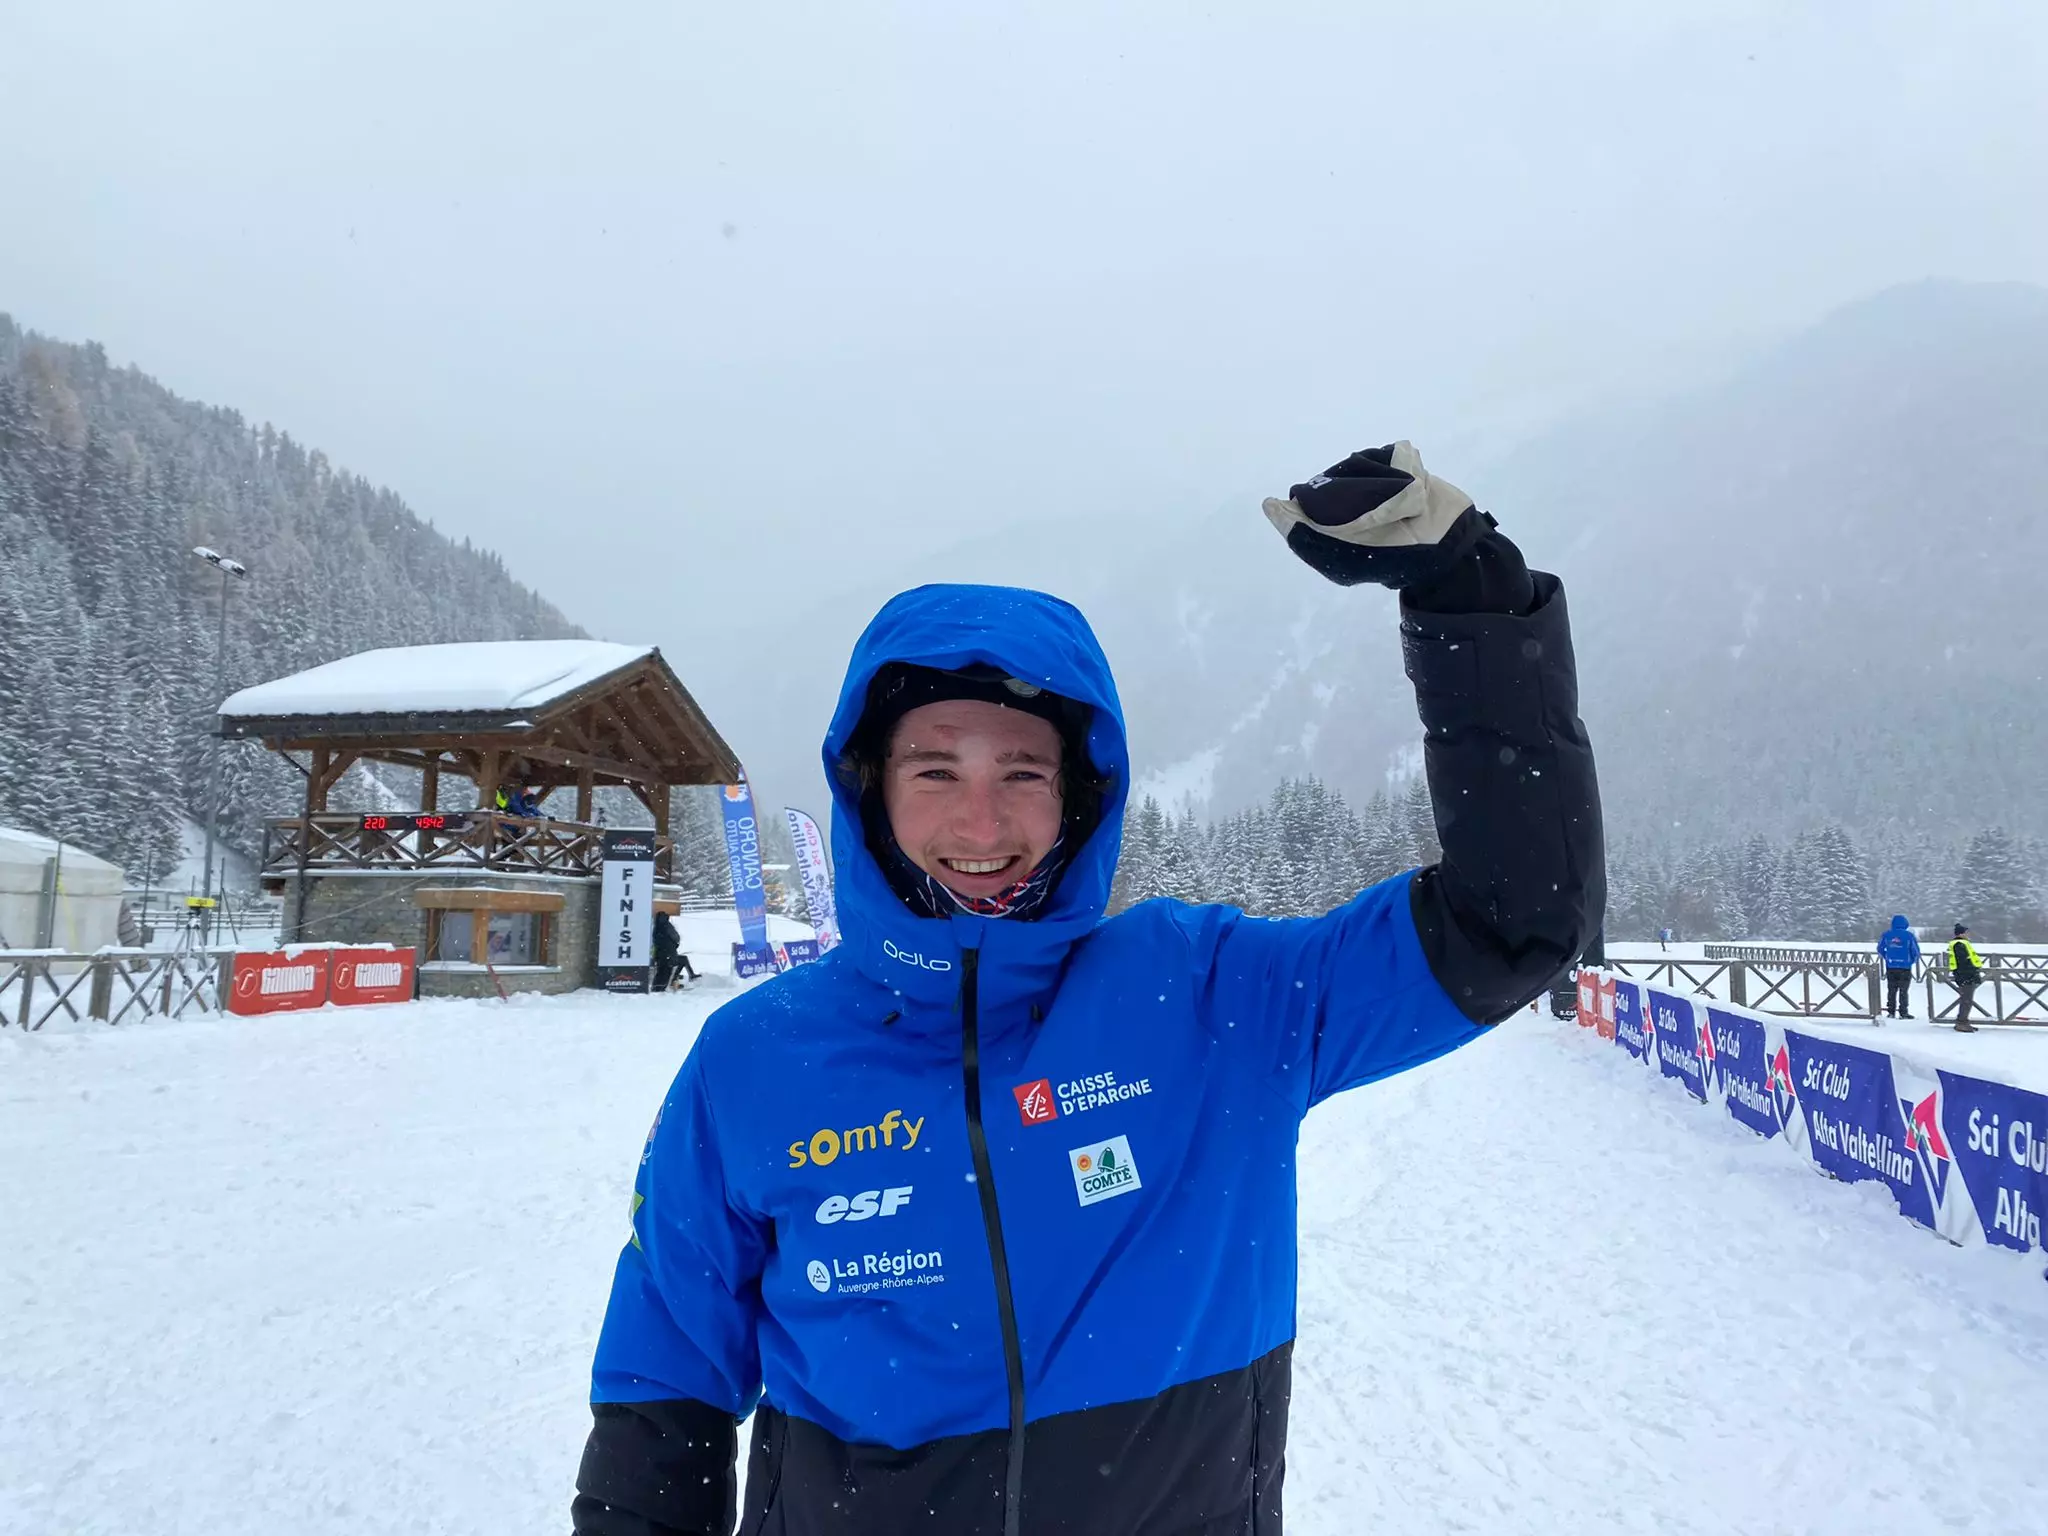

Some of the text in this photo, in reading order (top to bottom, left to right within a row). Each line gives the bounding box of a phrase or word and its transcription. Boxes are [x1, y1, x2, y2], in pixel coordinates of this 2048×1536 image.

[364, 817, 386, 829] 220
[618, 868, 634, 959] FINISH
[1717, 1027, 1726, 1052] Sci
[1057, 1071, 1116, 1099] CAISSE
[1061, 1078, 1152, 1116] D'EPARGNE
[1803, 1057, 1850, 1101] Sci Club
[789, 1109, 924, 1168] somfy
[1812, 1110, 1914, 1186] Alta Valtellina
[1968, 1109, 2048, 1176] Sci Clu
[1994, 1186, 2041, 1248] Alta
[833, 1248, 943, 1278] La Région
[837, 1274, 945, 1294] Auvergne-Rhône-Alpes
